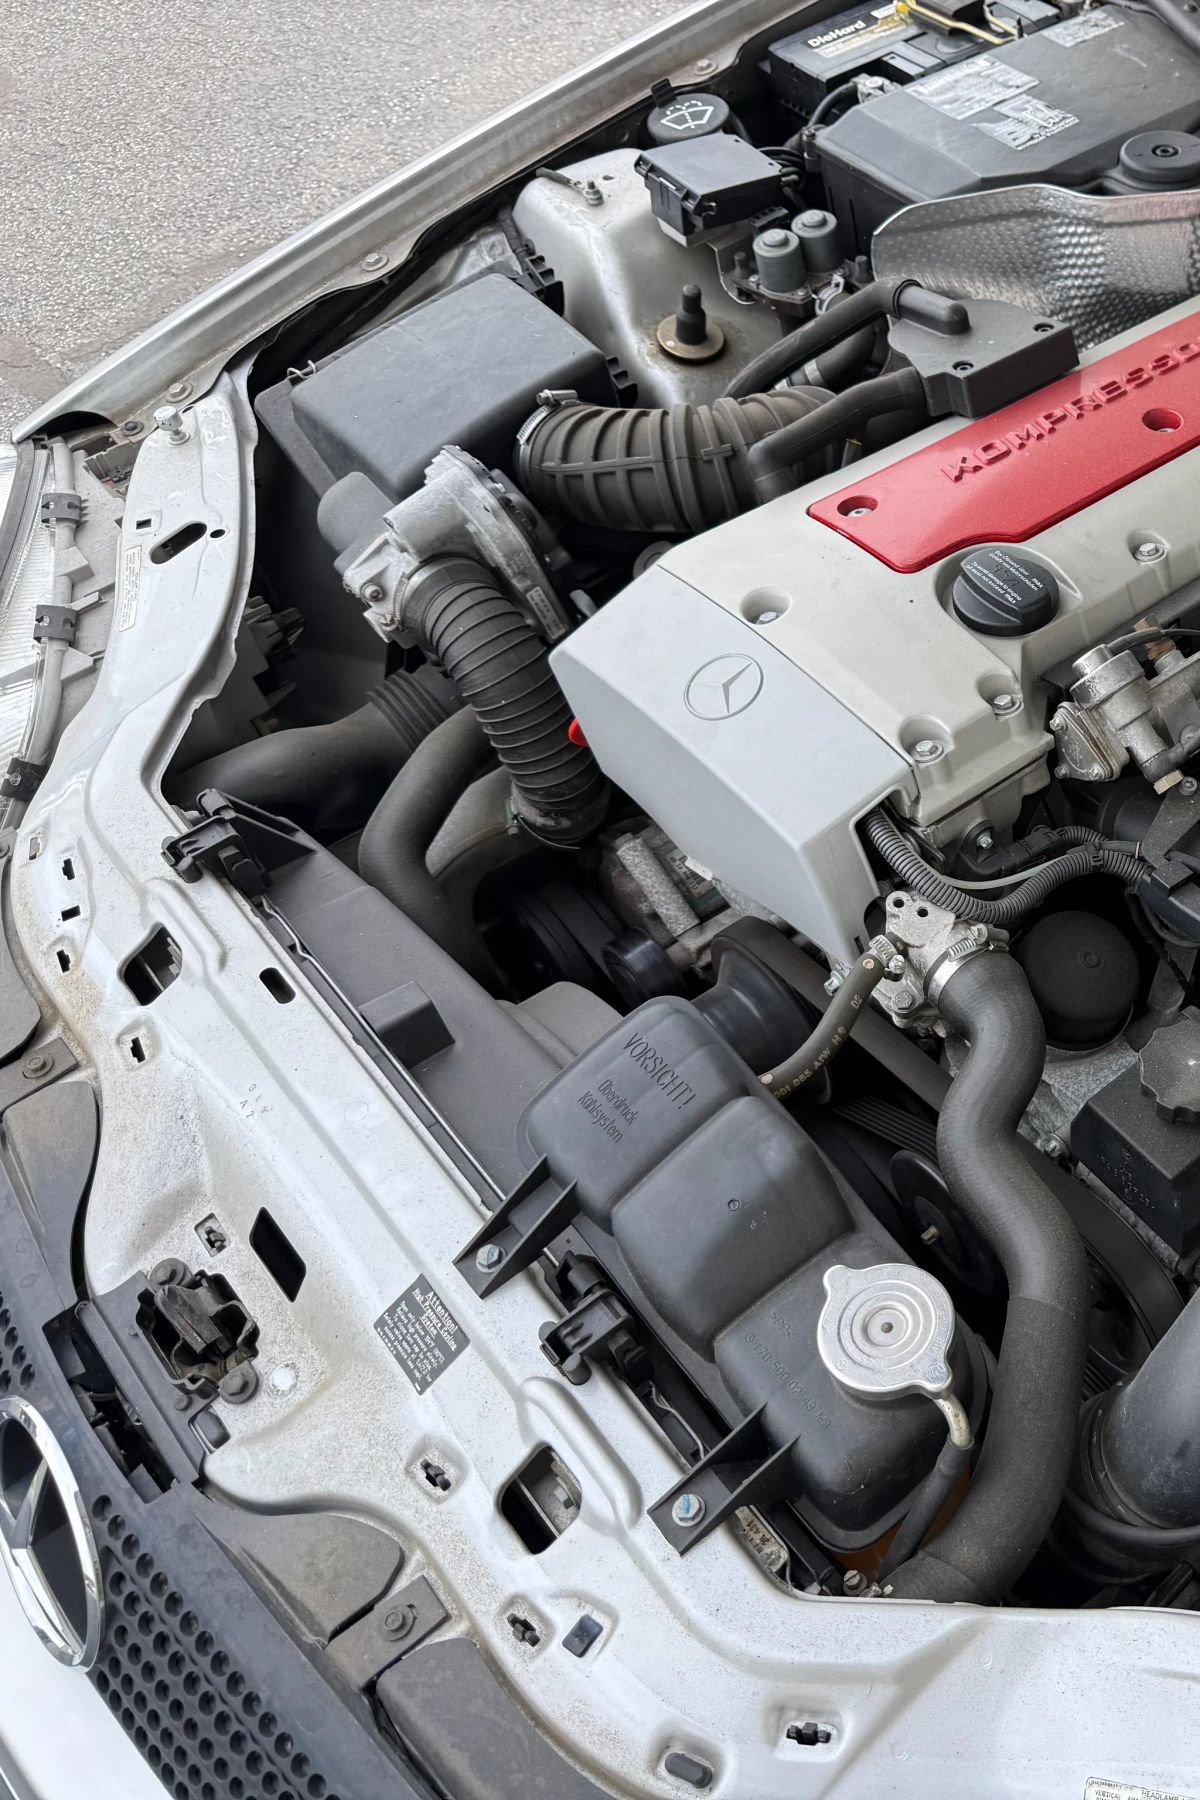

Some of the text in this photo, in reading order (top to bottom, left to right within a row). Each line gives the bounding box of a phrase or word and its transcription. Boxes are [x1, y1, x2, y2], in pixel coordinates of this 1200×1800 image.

[807, 20, 866, 47] DieHard
[1031, 577, 1044, 588] max
[1004, 593, 1017, 604] max
[623, 1032, 696, 1110] VORSICHT!
[413, 1288, 459, 1349] High Pressure Cooling
[426, 1291, 459, 1333] Attention!
[421, 1314, 439, 1335] System
[393, 1341, 408, 1359] pressure
[413, 1334, 427, 1352] pressure
[753, 1342, 774, 1363] 170
[769, 1360, 791, 1382] 500
